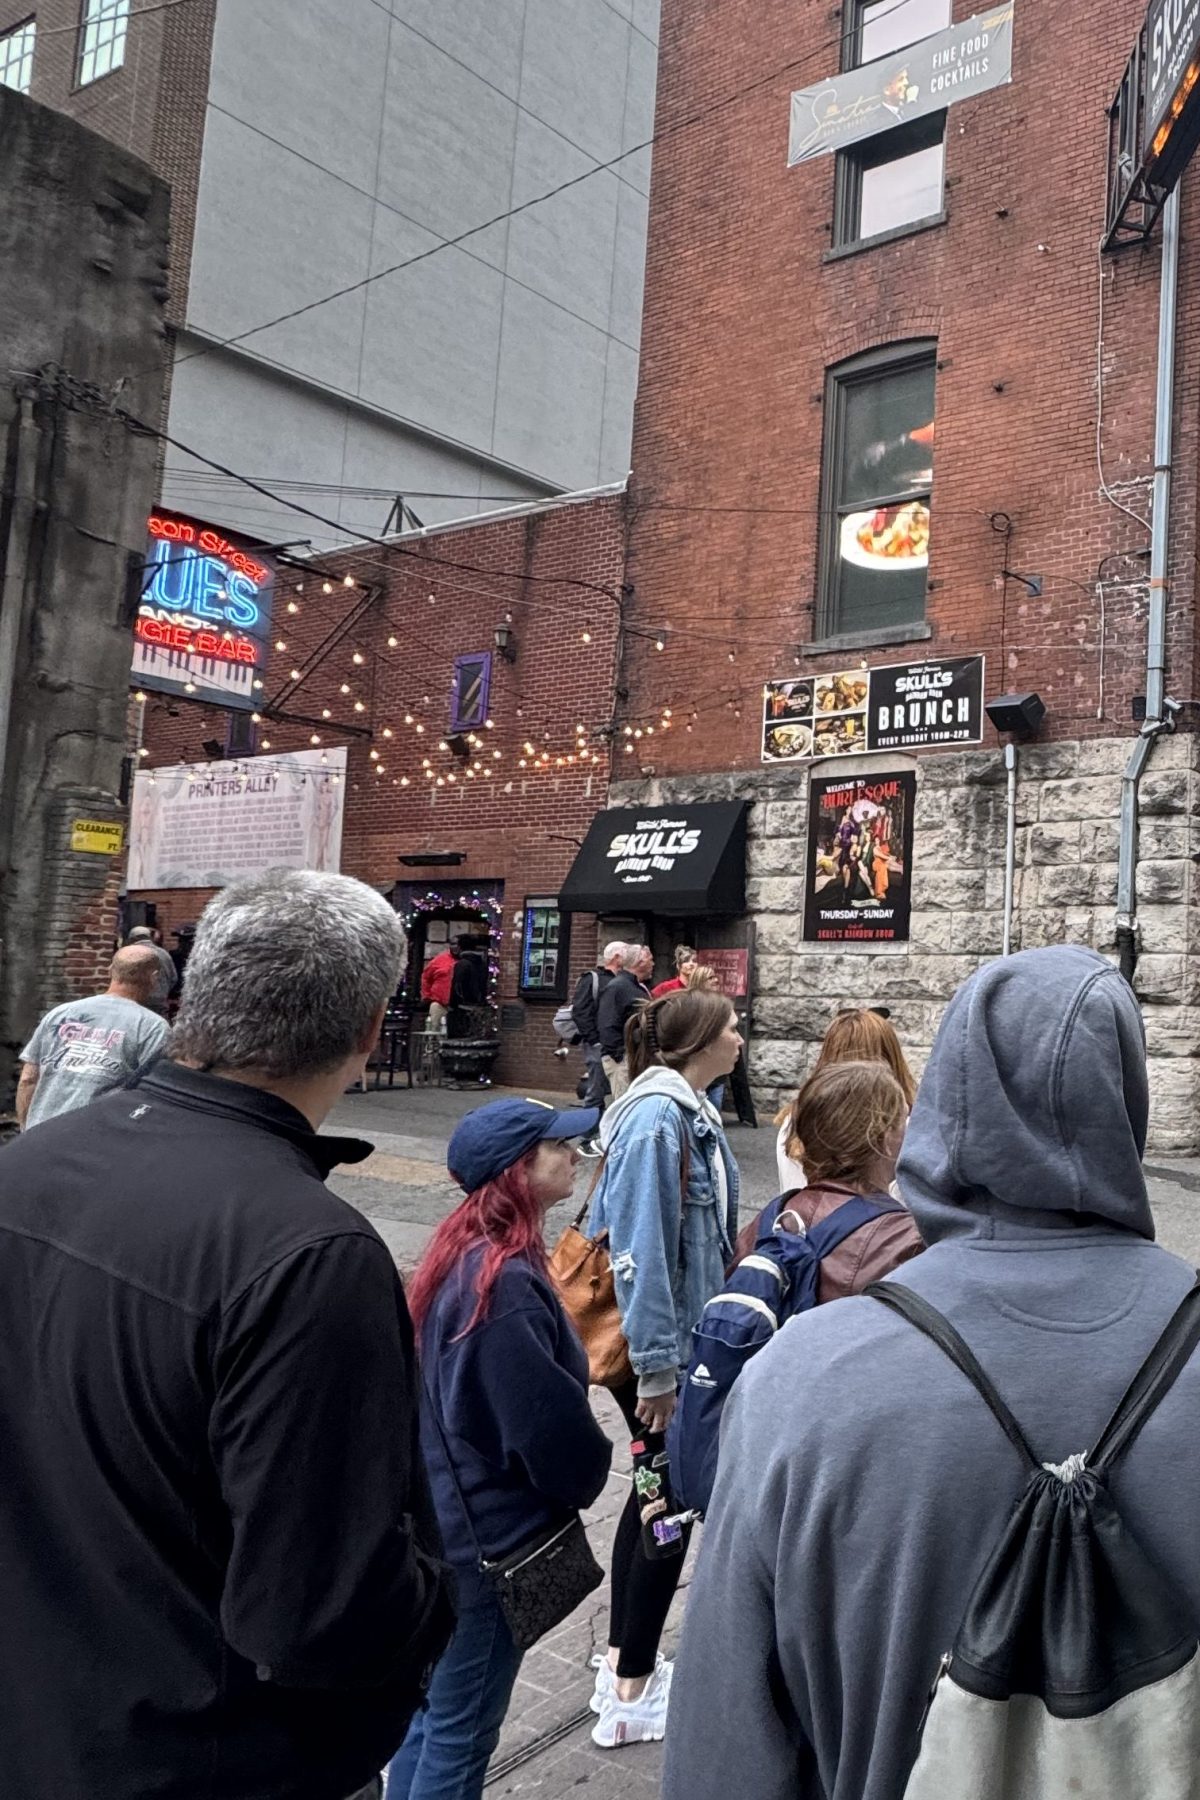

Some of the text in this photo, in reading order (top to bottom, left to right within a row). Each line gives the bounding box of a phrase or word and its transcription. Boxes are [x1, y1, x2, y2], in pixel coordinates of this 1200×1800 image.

[932, 33, 989, 69] FINE FOOD
[1152, 0, 1190, 91] SKU
[931, 58, 989, 93] COCKTAILS
[200, 531, 269, 583] Street
[143, 540, 258, 628] UES
[137, 620, 258, 664] GIE BAR
[895, 671, 953, 692] SKULL'S
[878, 697, 969, 730] BRUNCH
[188, 777, 279, 799] PRINTERS ALLEY
[826, 780, 866, 793] WELCOME TO
[76, 823, 121, 836] CLEARANCE
[606, 829, 701, 857] SKULL'S
